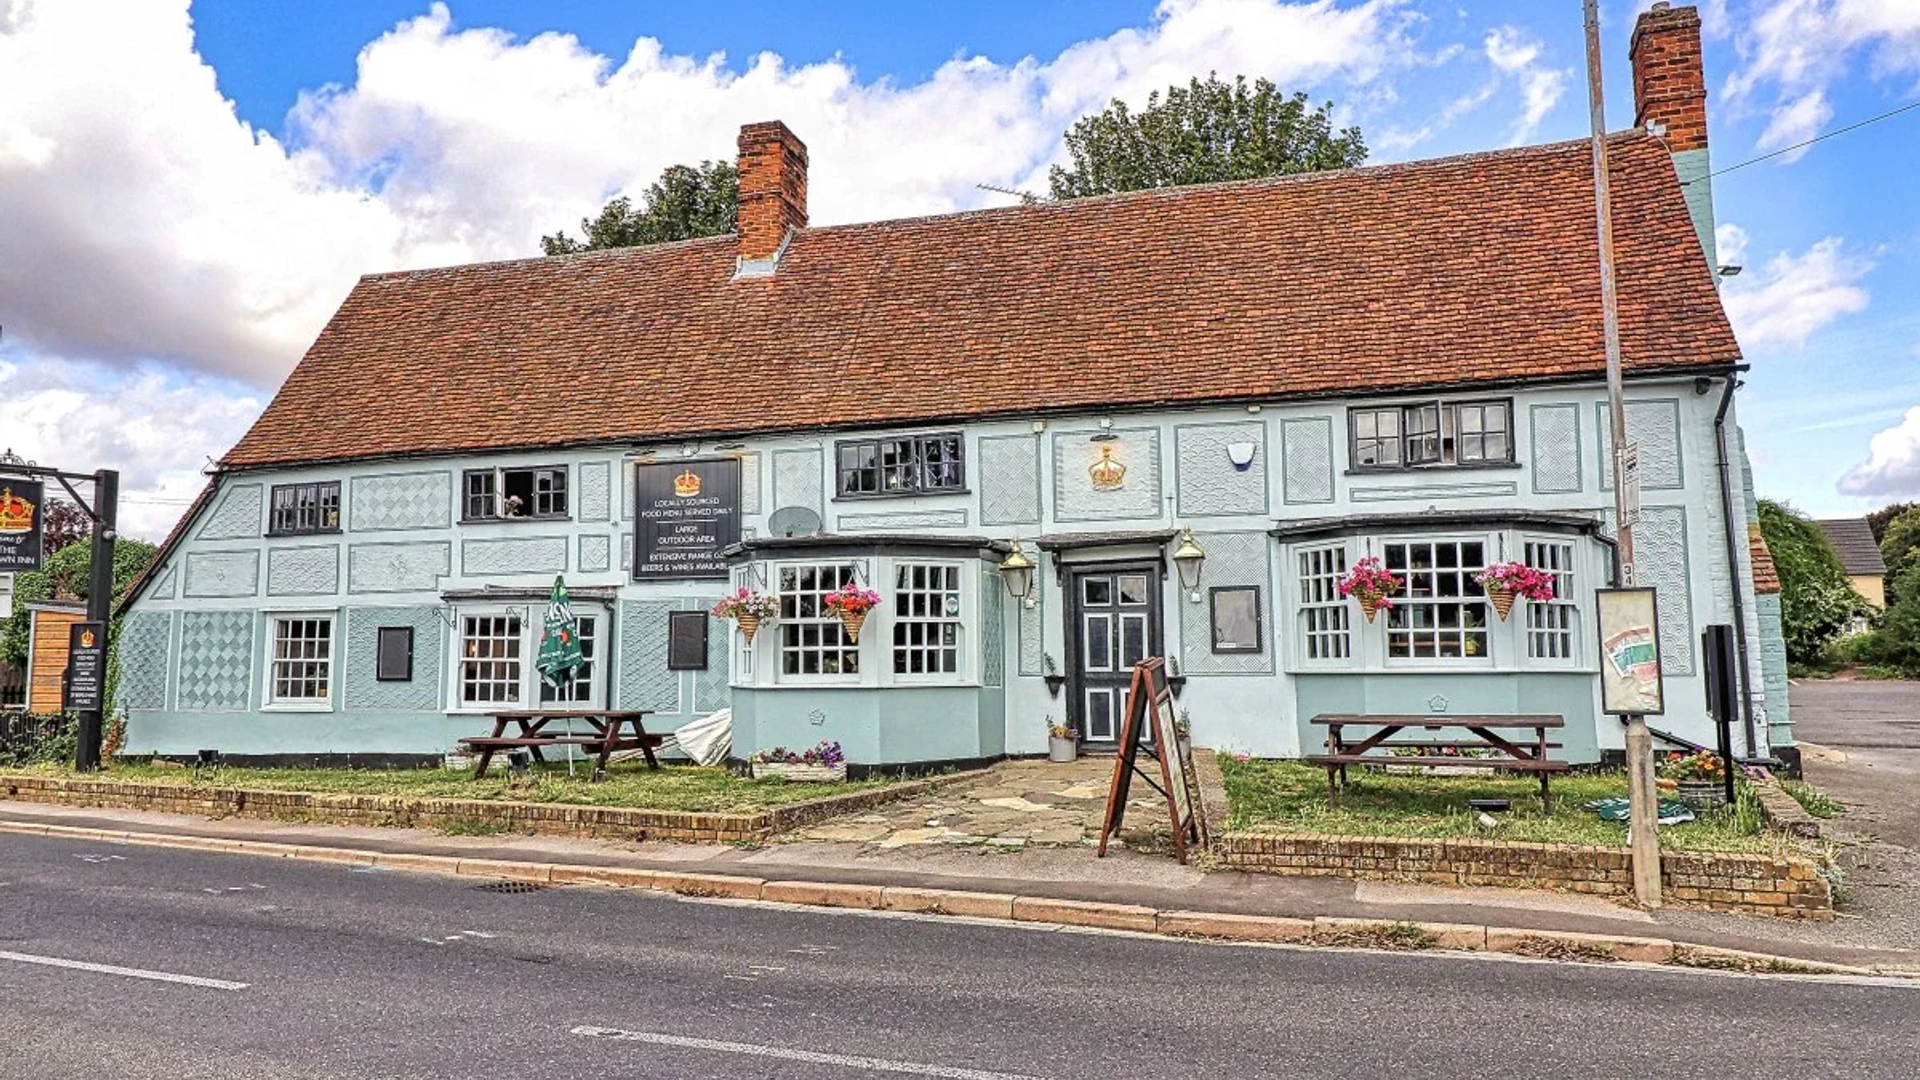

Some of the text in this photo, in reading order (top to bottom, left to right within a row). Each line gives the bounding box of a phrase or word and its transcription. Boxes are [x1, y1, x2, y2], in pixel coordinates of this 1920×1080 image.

[654, 497, 719, 507] LOCALLY SOURCED
[662, 509, 683, 517] MENU
[684, 508, 711, 516] SERVED
[712, 507, 733, 515] DAILY
[658, 535, 715, 544] OUTDOOR AREA
[17, 556, 35, 564] INN
[650, 552, 687, 561] EXTENSIVE
[688, 551, 713, 560] RANGE
[664, 564, 670, 572] &
[670, 563, 694, 571] WINES
[1624, 565, 1632, 575] 3
[1624, 575, 1632, 585] 4
